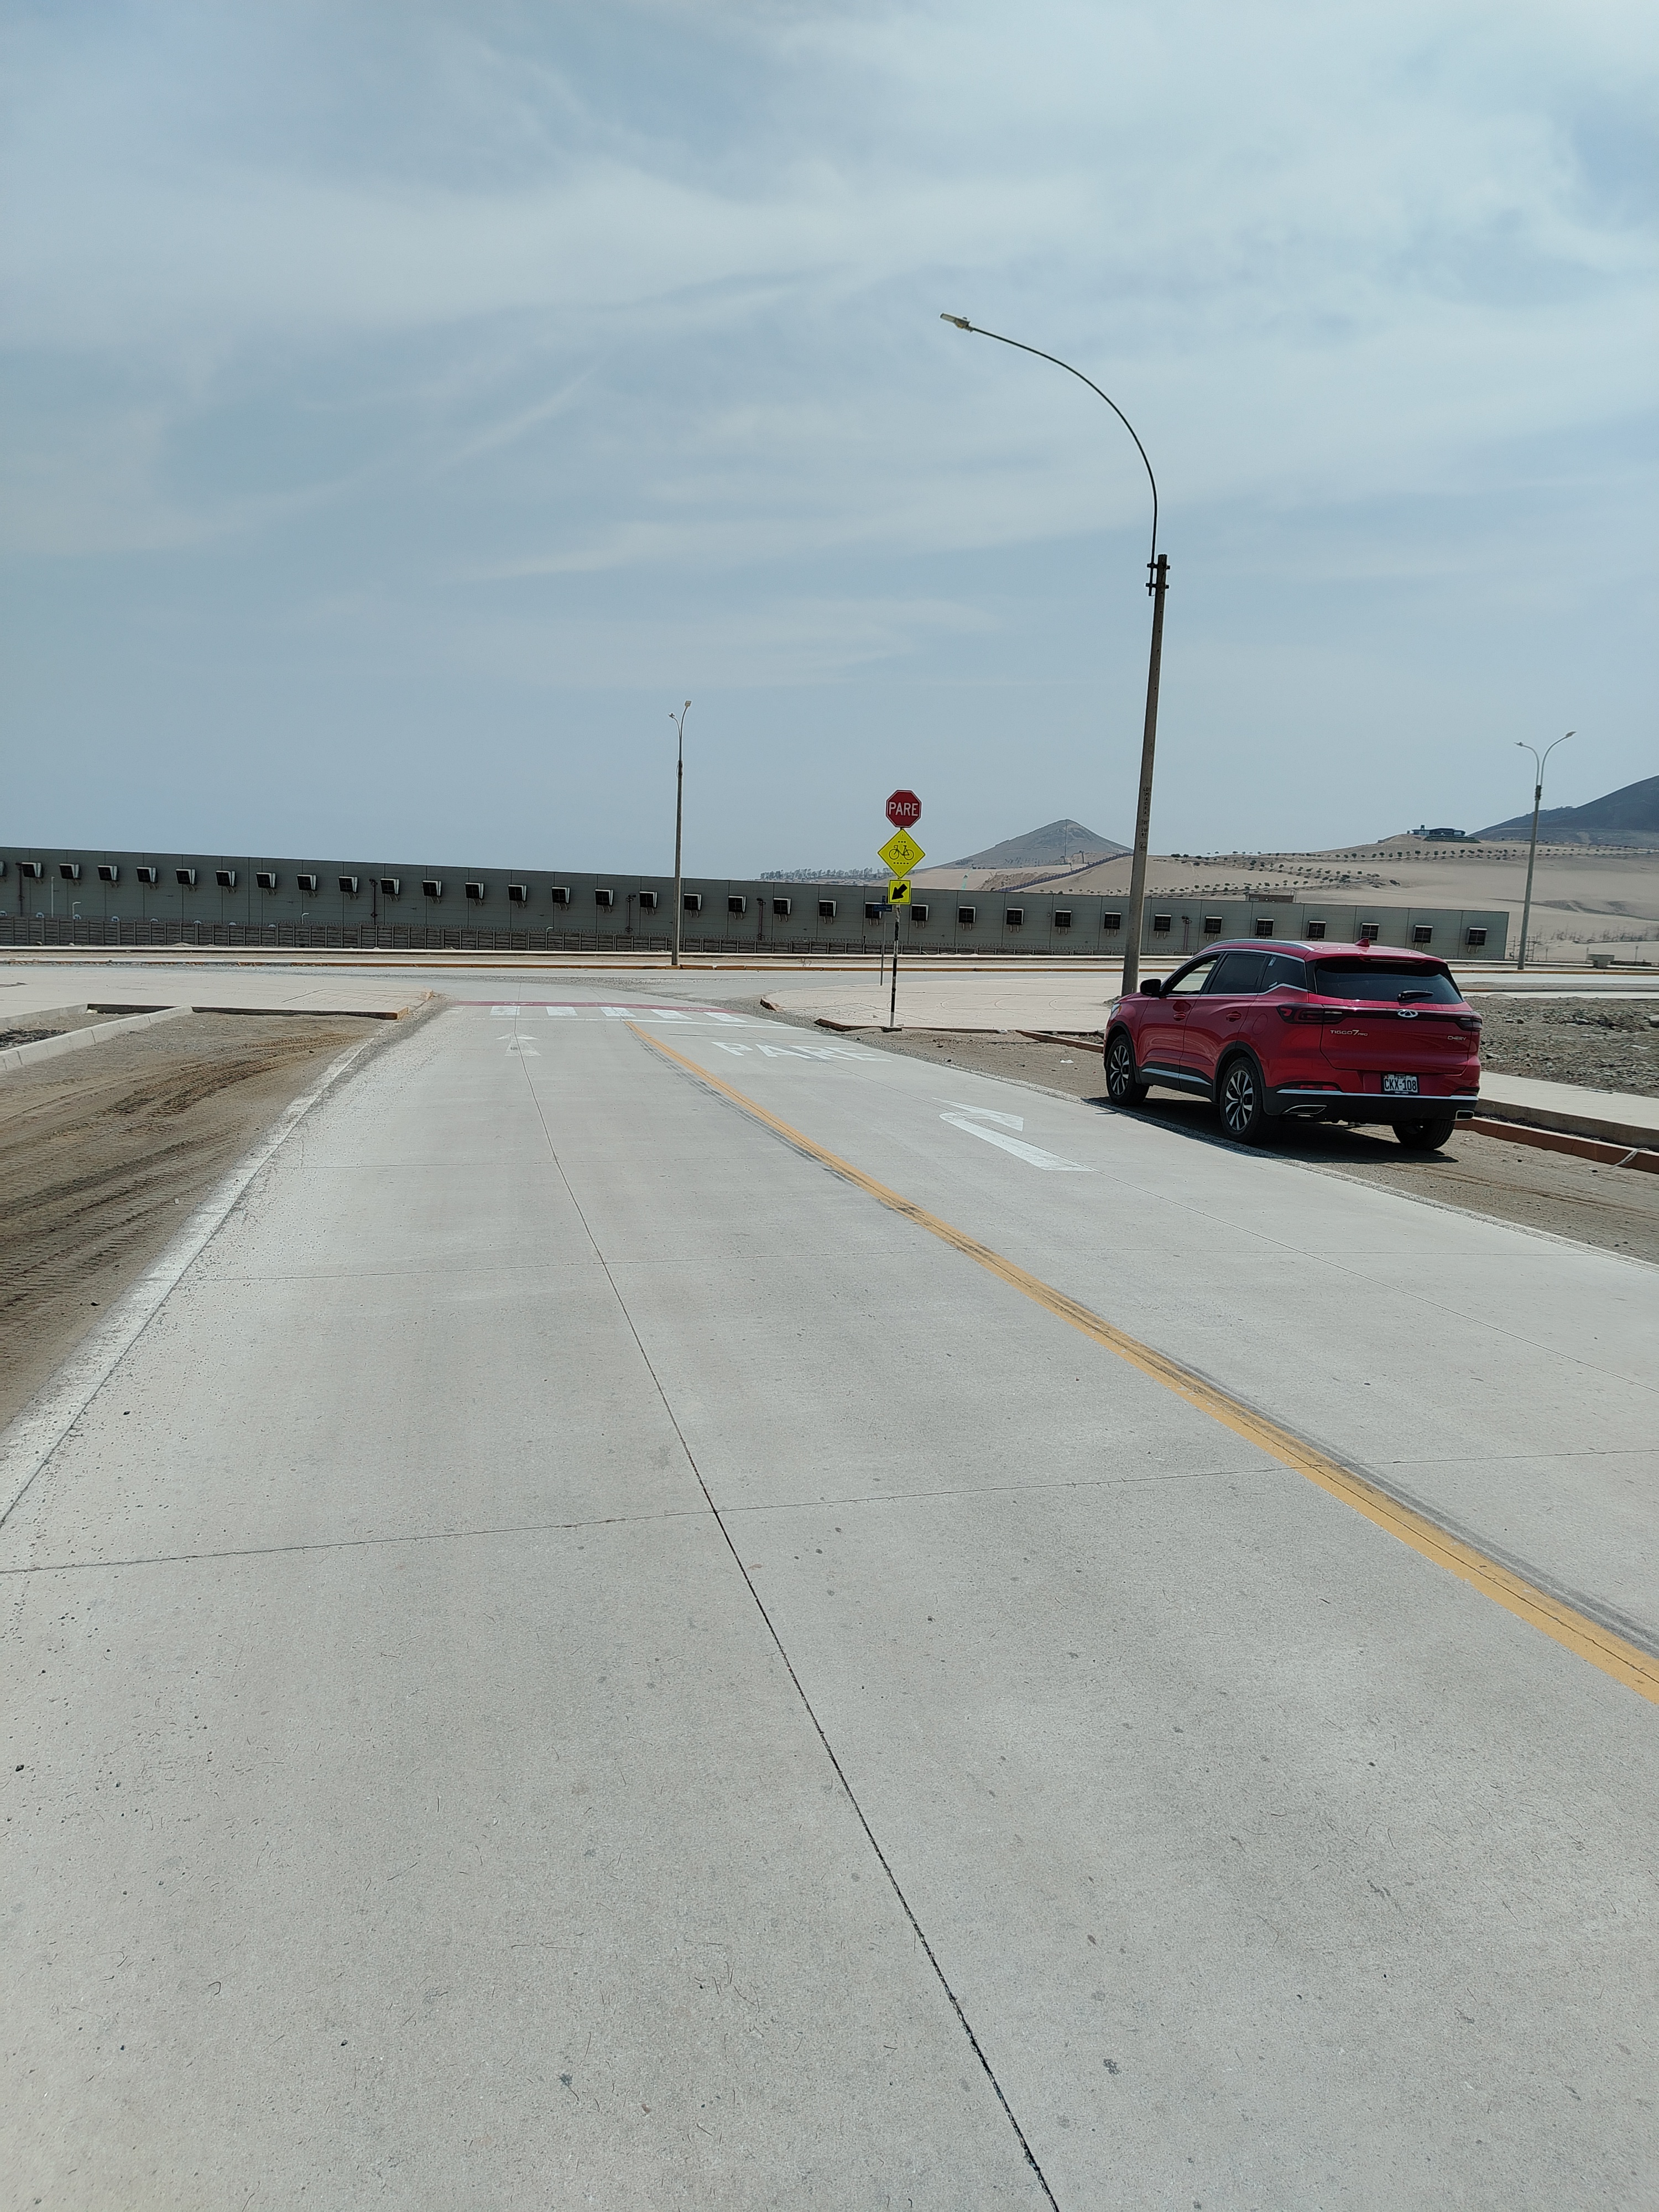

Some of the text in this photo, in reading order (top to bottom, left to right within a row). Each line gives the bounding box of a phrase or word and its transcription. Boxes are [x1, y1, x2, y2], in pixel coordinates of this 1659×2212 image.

[889, 801, 919, 817] PARE
[711, 1042, 893, 1062] PARE
[1384, 1079, 1417, 1091] CKX-108
